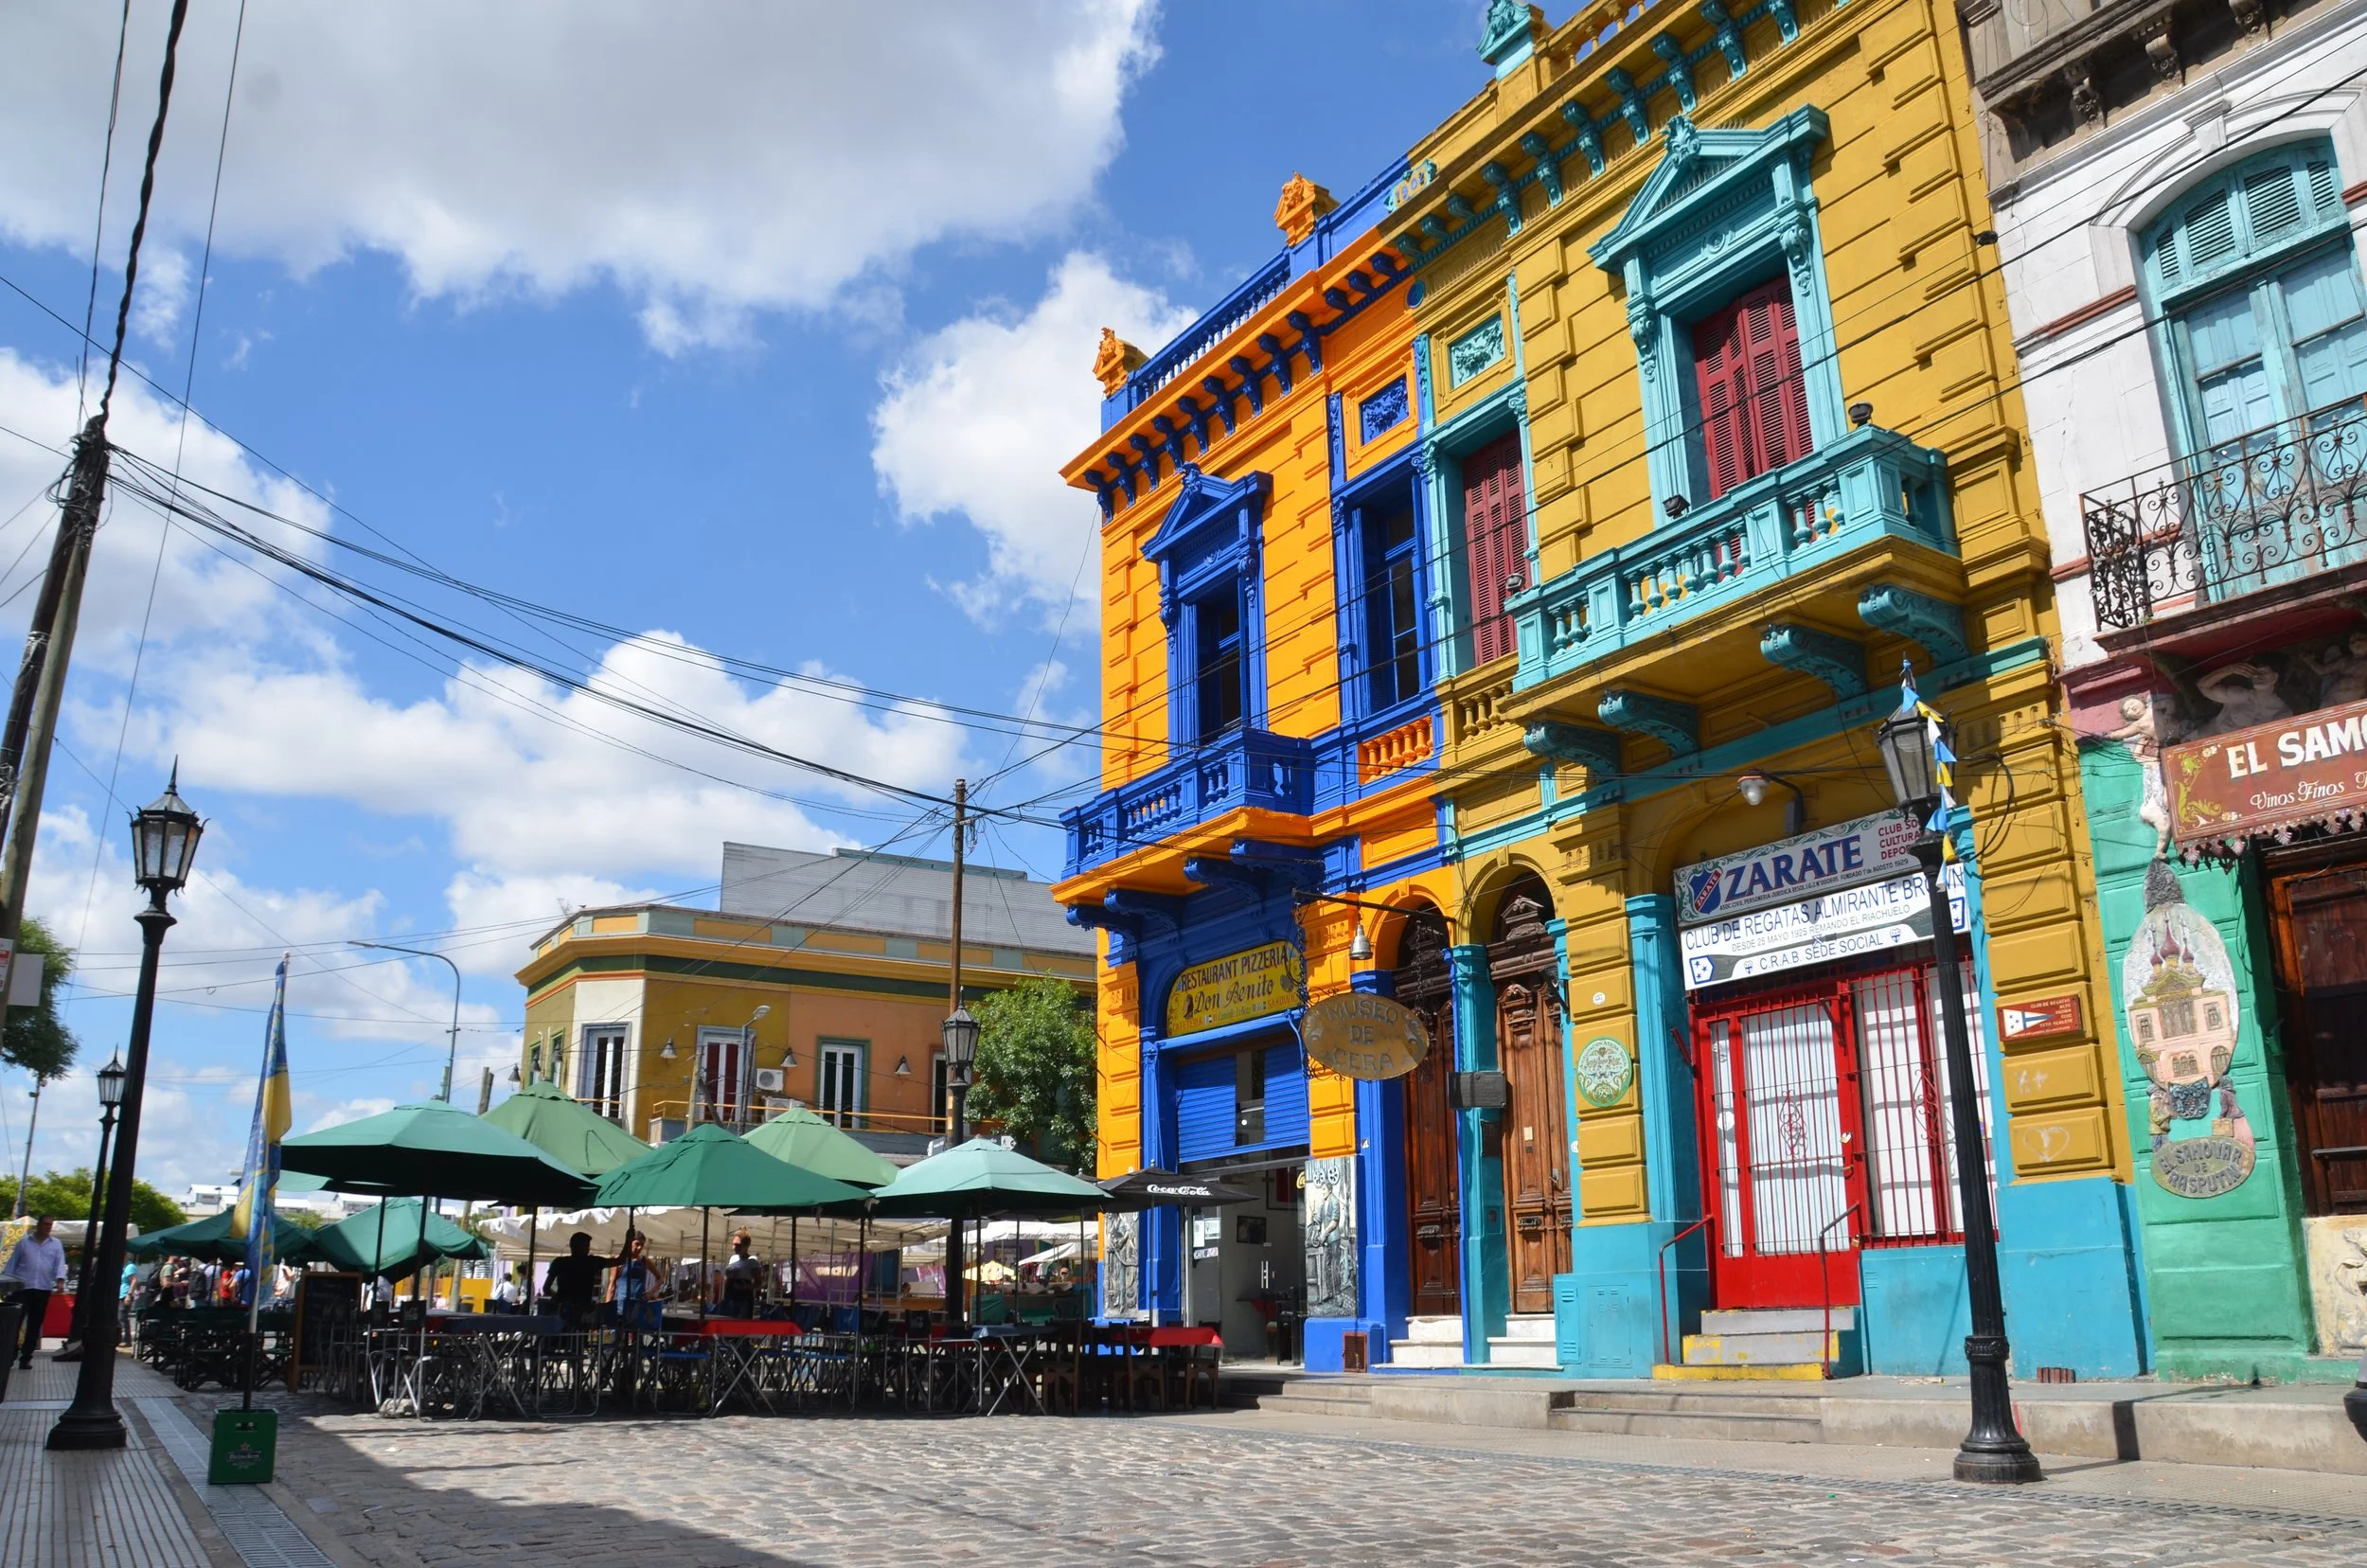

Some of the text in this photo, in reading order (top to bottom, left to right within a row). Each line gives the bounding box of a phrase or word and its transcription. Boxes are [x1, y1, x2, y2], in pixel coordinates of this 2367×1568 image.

[2226, 714, 2367, 778] EL SAM
[2250, 780, 2345, 810] Vinos Finos
[1878, 819, 1918, 836] CLUB SO
[1879, 830, 1921, 848] CULTURA
[1725, 834, 1864, 902] ZARATE
[1697, 874, 1718, 906] ZARATE
[1685, 865, 1965, 951] CLUB DE REGATAS ALMIRANTE BRN
[1732, 904, 1911, 953] DESDE 25 MAYO 1925 REMANDO EL RIACHUELO
[1182, 945, 1288, 991] RESTAURANT PIZZERIA
[1759, 934, 1884, 971] C.R.A.B. SEDE SOCIAL
[1194, 990, 1220, 1014] Don
[1223, 973, 1274, 1008] Benito
[1324, 999, 1398, 1025] MUSEO
[1349, 1025, 1374, 1044] DE
[1333, 1047, 1395, 1072] CERA
[2158, 1140, 2243, 1175] EL SAMOVAR
[2194, 1163, 2208, 1173] DE
[1147, 1184, 1212, 1196] Coca-Cola
[2168, 1165, 2242, 1194] RASPUTIN
